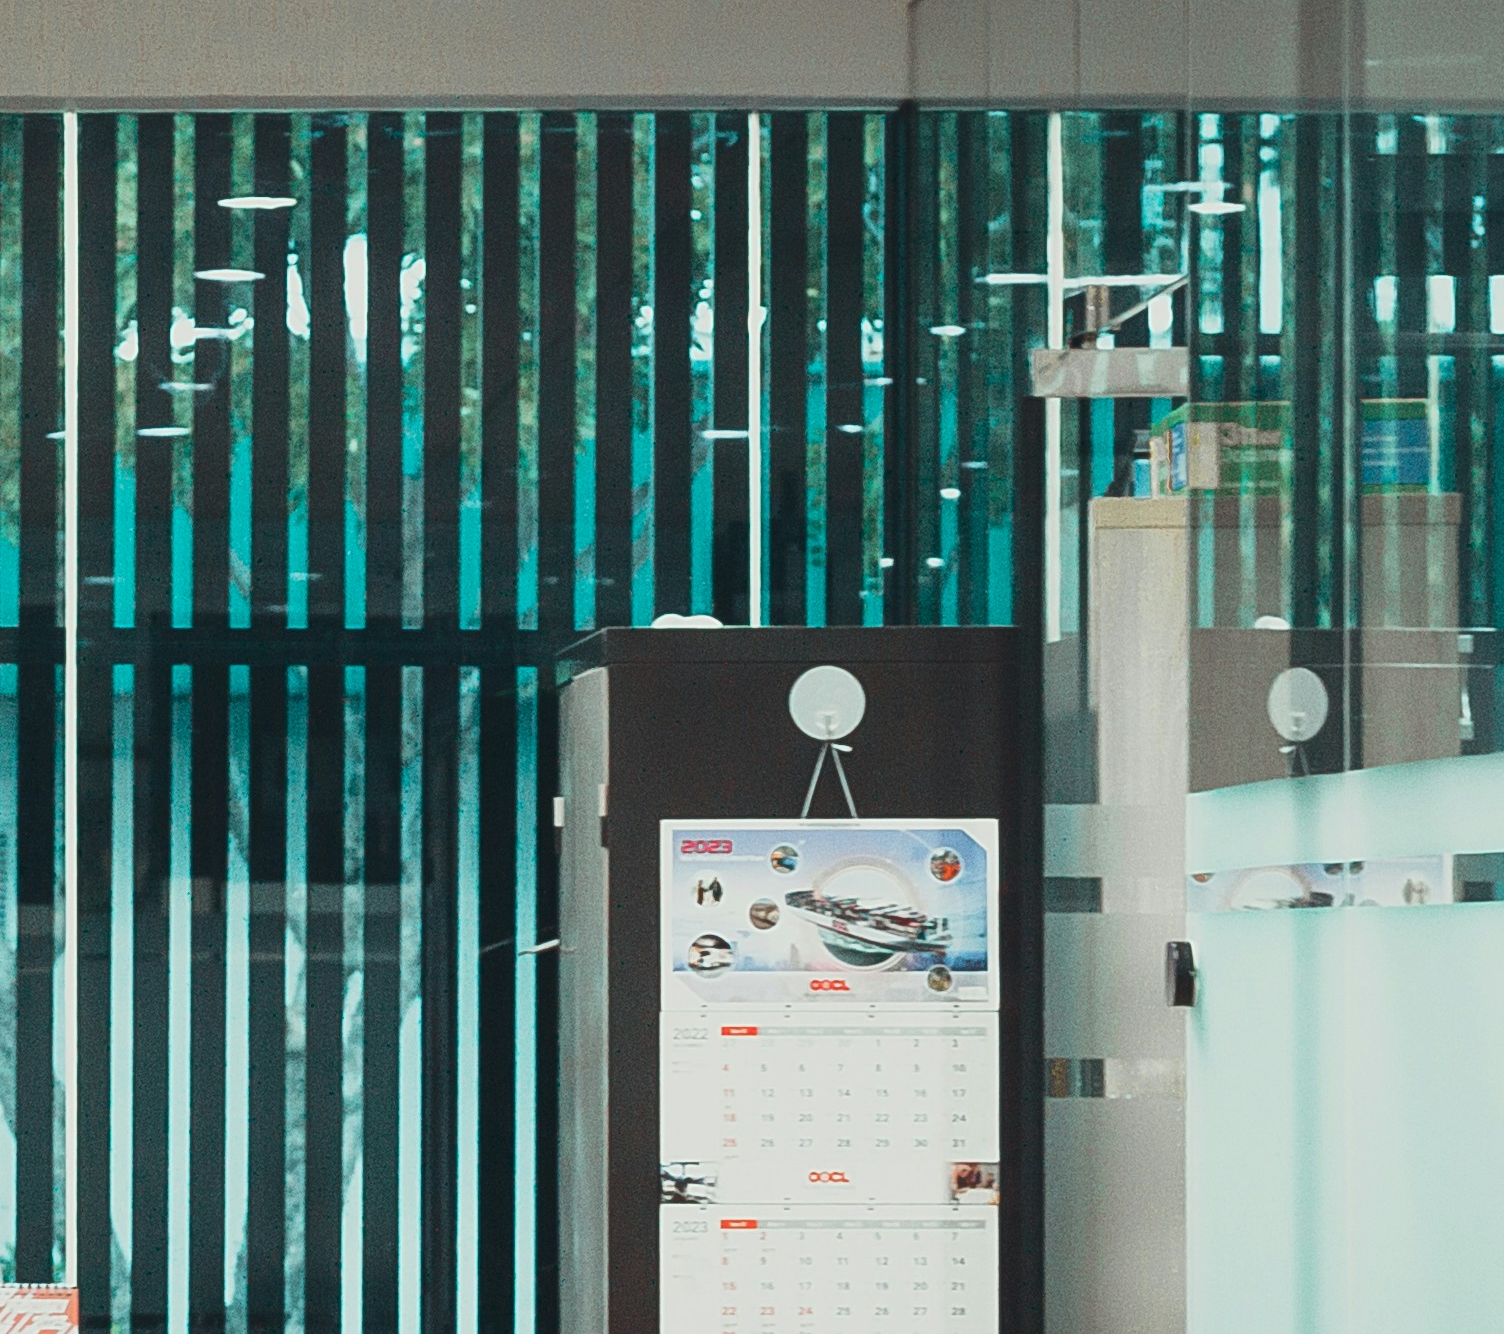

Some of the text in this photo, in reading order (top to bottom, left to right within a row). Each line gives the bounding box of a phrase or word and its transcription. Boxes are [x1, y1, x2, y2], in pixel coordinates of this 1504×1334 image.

[680, 839, 734, 855] 2023
[672, 1027, 710, 1041] 2022
[672, 1220, 709, 1234] 2023
